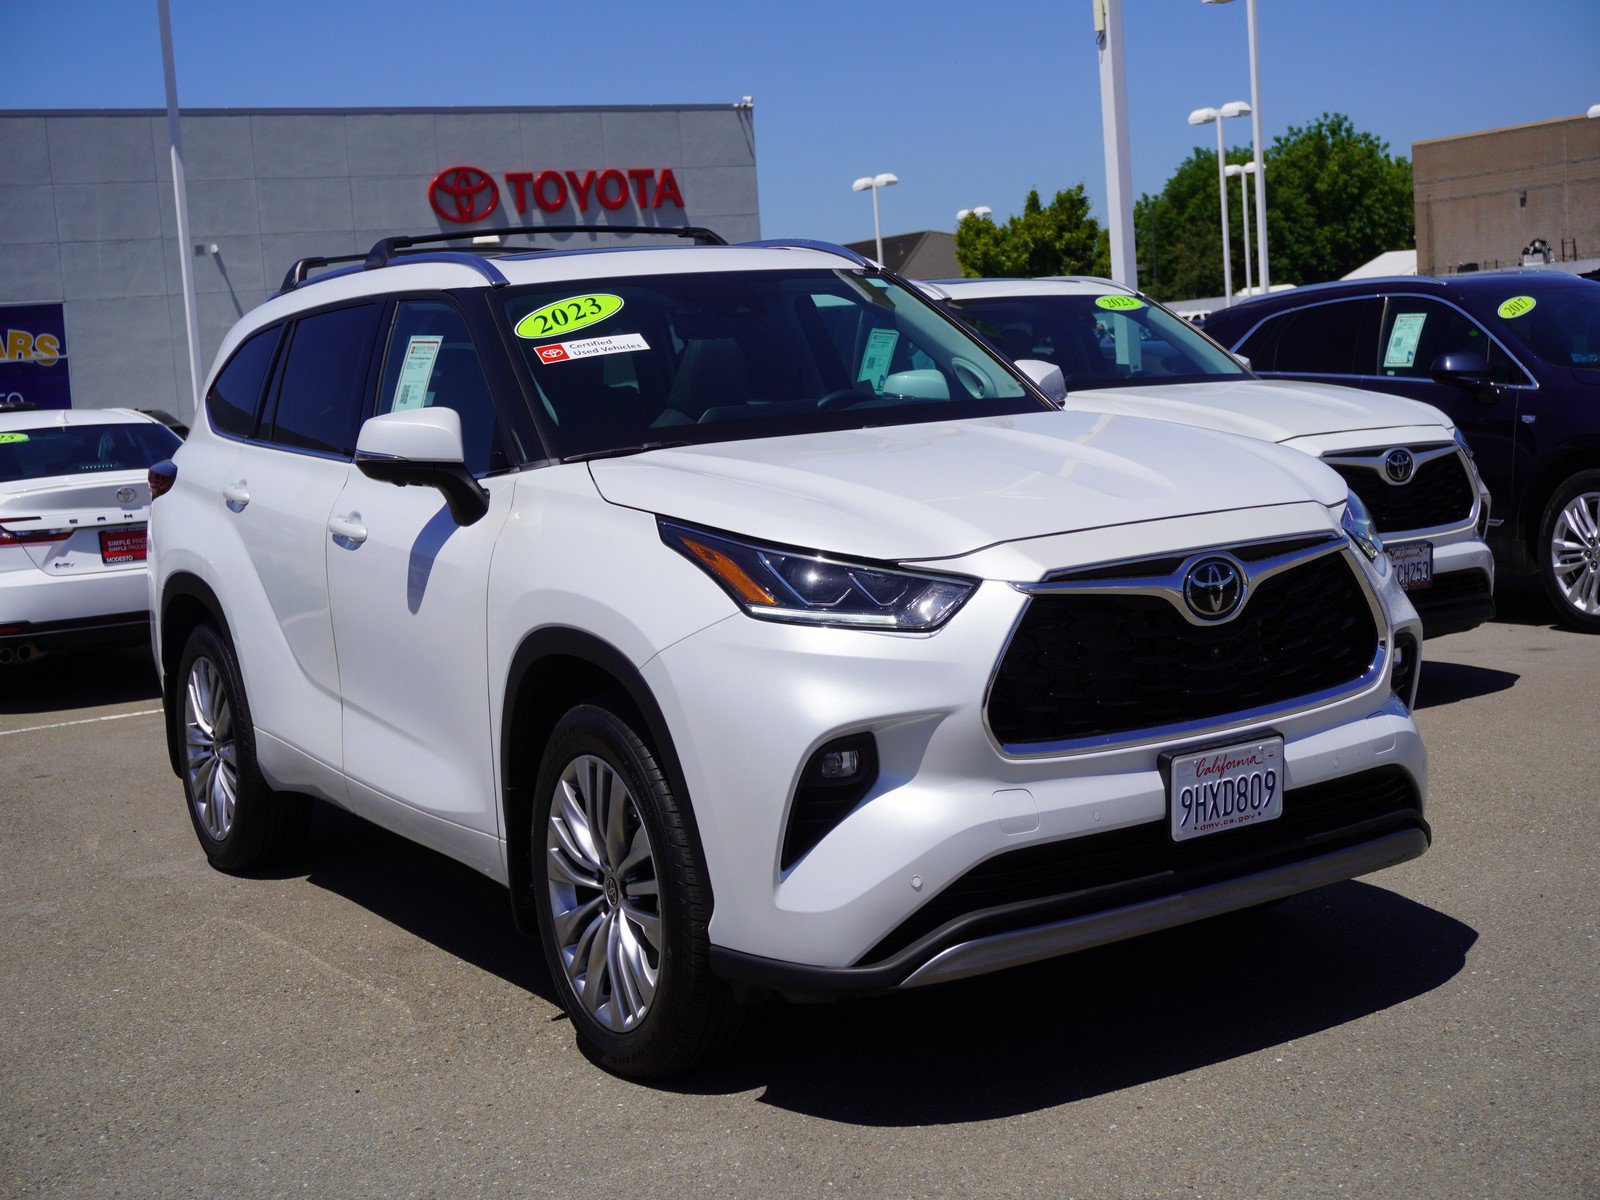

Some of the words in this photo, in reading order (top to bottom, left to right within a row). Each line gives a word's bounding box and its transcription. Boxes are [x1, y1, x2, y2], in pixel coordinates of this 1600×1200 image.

[505, 168, 685, 214] TOYOTA
[1102, 296, 1135, 308] 2023
[1503, 298, 1528, 316] 2017
[533, 297, 602, 334] 2023
[569, 339, 613, 350] Certified
[573, 348, 599, 356] Used
[601, 343, 642, 353] Vehicles
[106, 555, 134, 563] MODESTO
[1392, 562, 1429, 584] CH253
[1196, 751, 1263, 778] California
[1180, 769, 1276, 827] 9HXD809
[1200, 813, 1256, 831] dmv.ca.gov
